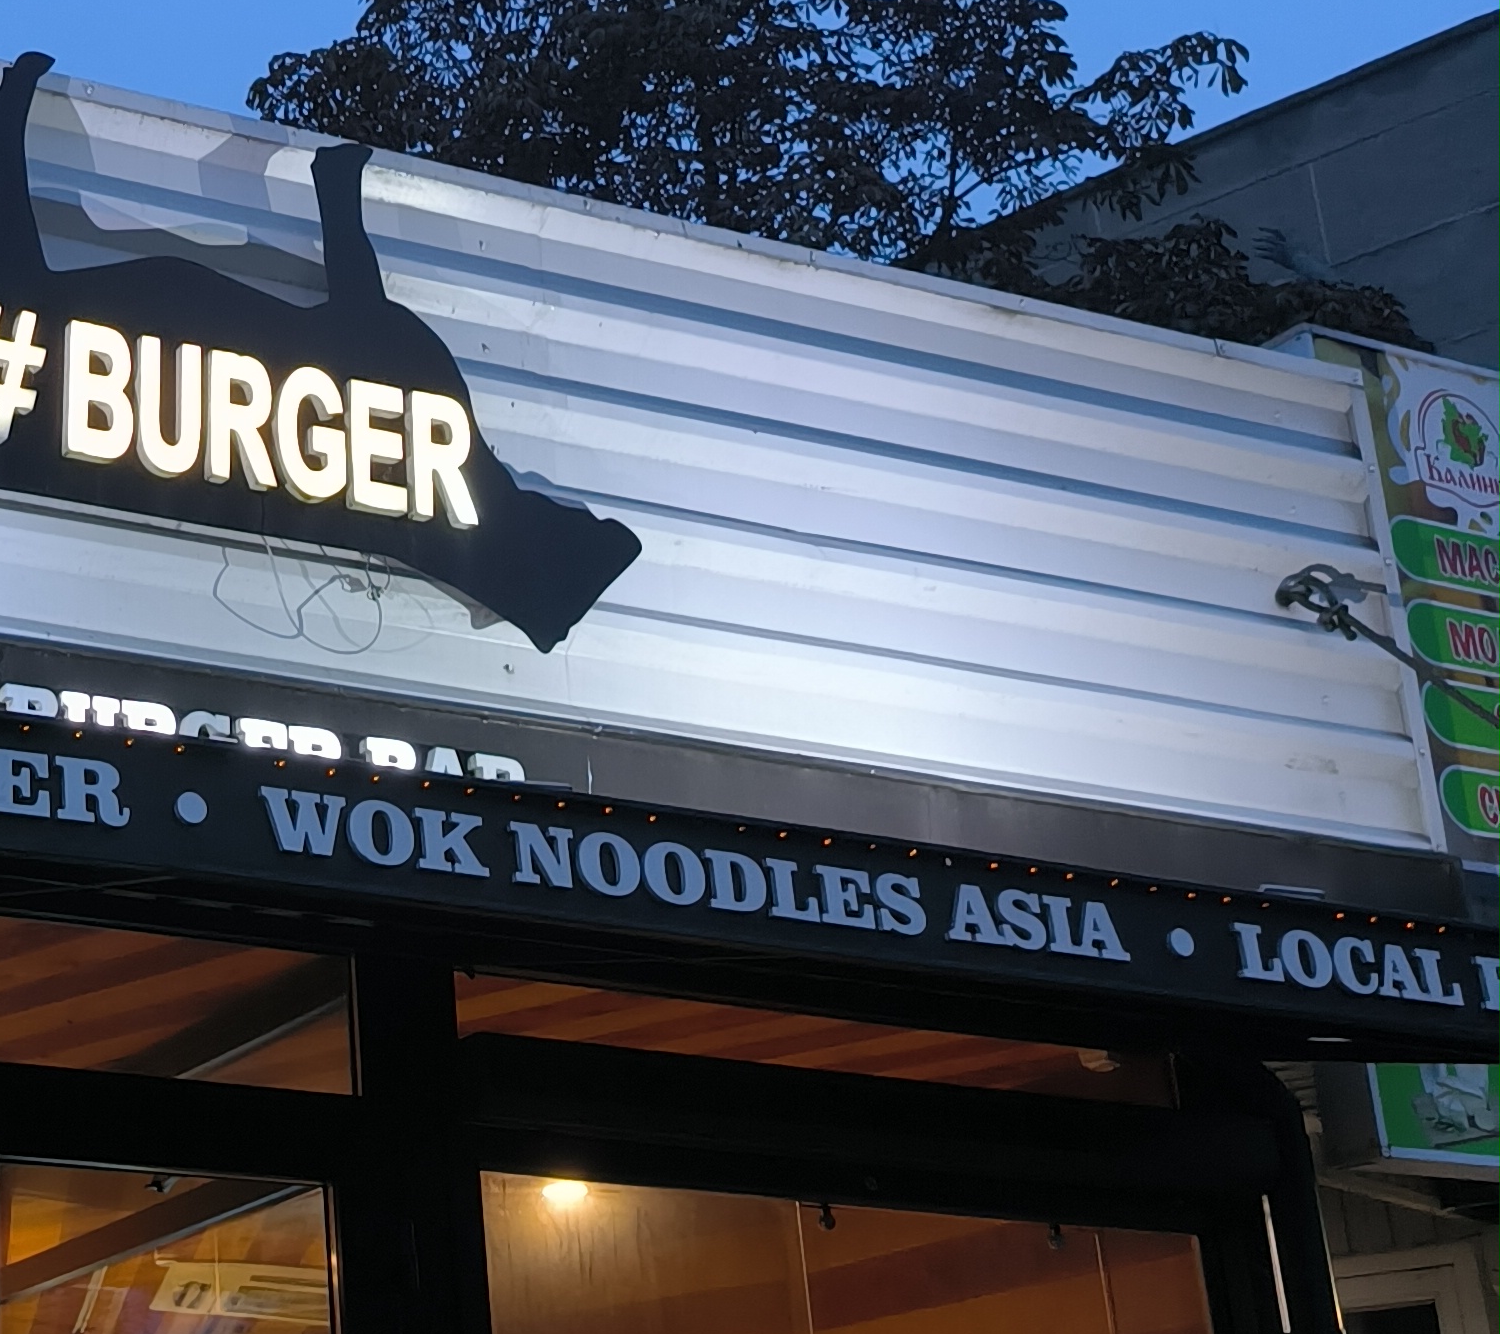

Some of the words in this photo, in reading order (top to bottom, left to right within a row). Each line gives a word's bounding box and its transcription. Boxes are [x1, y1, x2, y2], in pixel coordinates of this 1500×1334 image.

[1445, 617, 1500, 667] МО
[258, 784, 490, 878] WOK
[506, 820, 928, 937] NOODLES
[945, 883, 1131, 962] ASIA
[1230, 921, 1465, 1006] LOCAL
